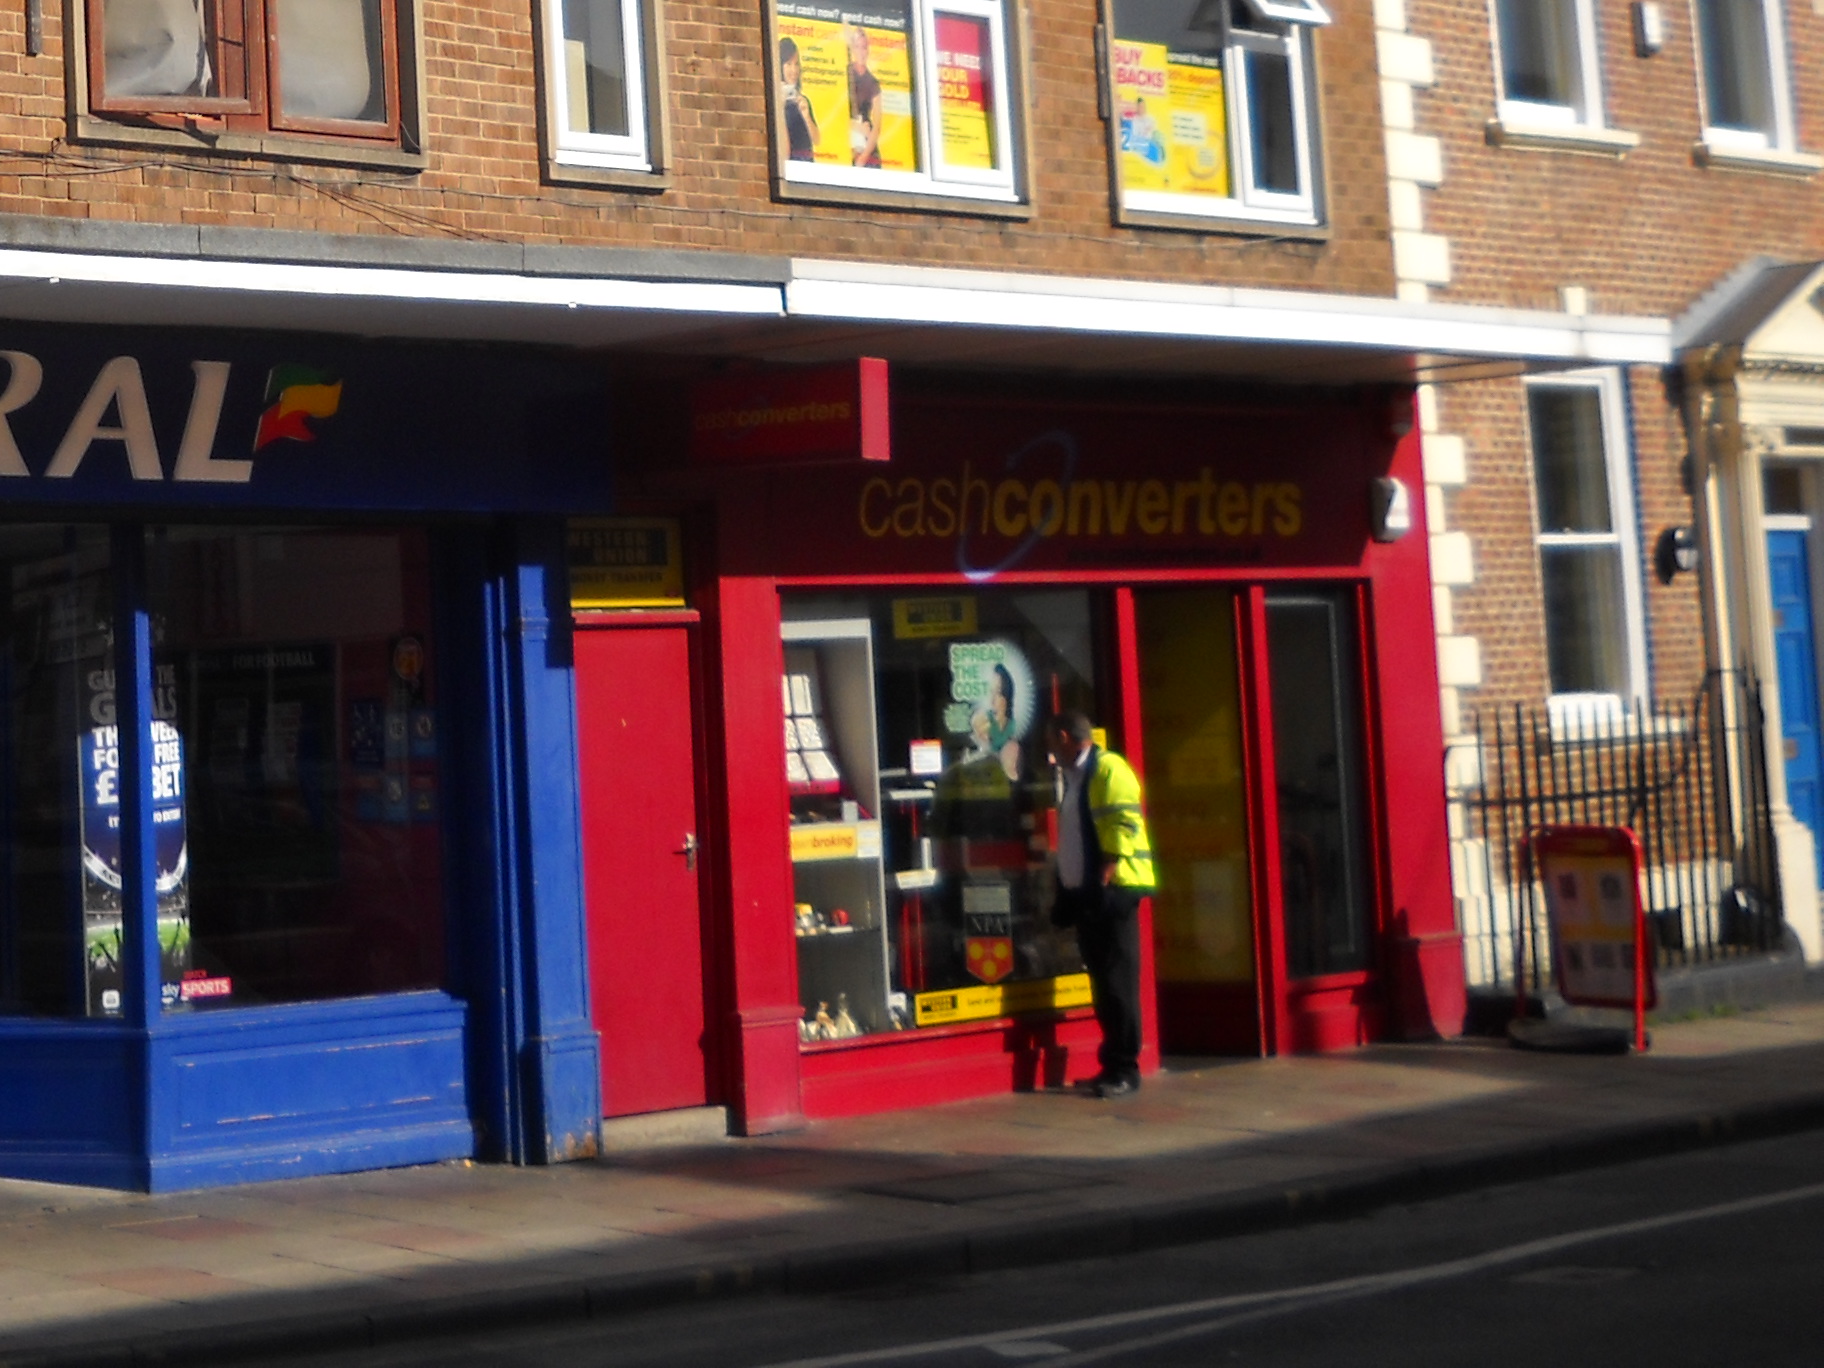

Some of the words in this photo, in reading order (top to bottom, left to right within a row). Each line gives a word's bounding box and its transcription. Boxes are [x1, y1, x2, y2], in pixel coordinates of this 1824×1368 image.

[1117, 66, 1165, 89] BACKS
[858, 460, 1304, 538] cashconverters
[950, 645, 1005, 663] SPREAD
[953, 663, 980, 680] THE
[954, 680, 990, 699] COST
[161, 982, 180, 998] sky
[181, 979, 230, 996] SPORTS
